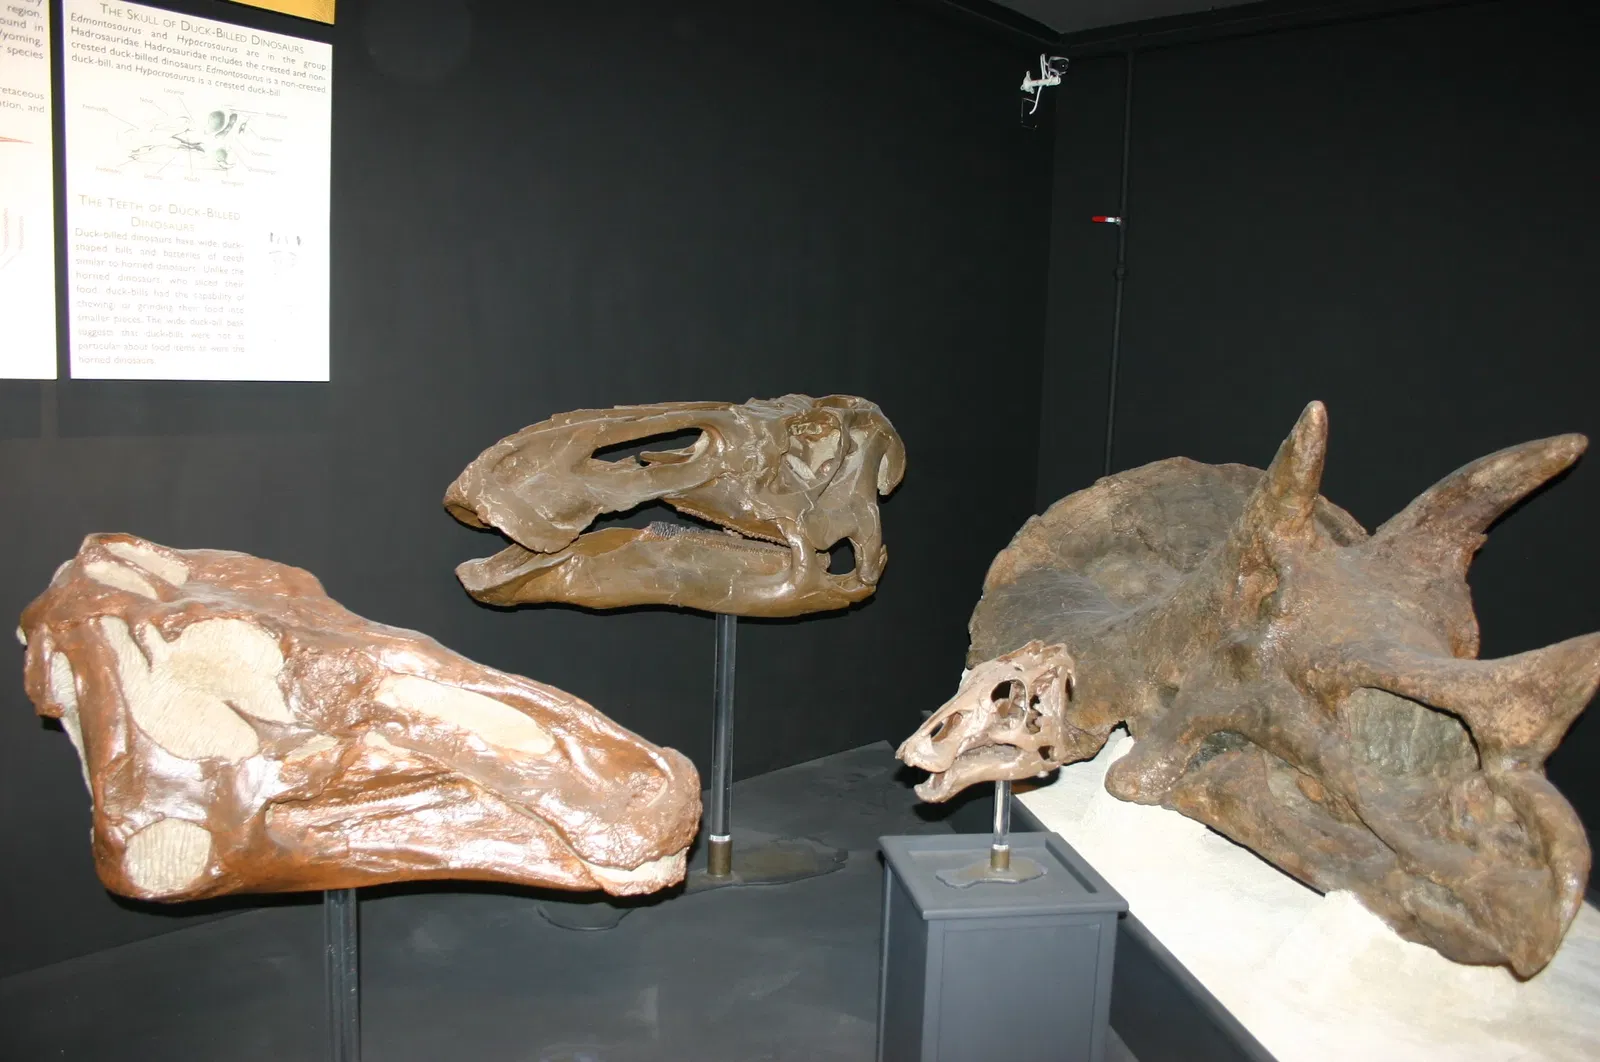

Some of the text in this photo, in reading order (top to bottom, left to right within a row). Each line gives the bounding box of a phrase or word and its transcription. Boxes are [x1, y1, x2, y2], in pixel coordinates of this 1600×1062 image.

[6, 4, 43, 18] region.
[0, 17, 44, 33] ound in
[99, 2, 305, 54] THE SKULL OF DUCK-BILLED DINOSAURS
[7, 46, 44, 60] species
[151, 31, 168, 40] and
[246, 49, 260, 58] are
[267, 52, 275, 60] in
[282, 55, 296, 64] the
[303, 60, 327, 71] group
[71, 41, 107, 54] crested
[109, 47, 158, 64] duck-billed
[265, 75, 272, 84] is
[280, 79, 326, 94] non-crested
[144, 40, 207, 60] Hadrosauridae
[210, 54, 243, 67] includes
[245, 59, 259, 69] the
[261, 63, 291, 76] crested
[292, 69, 307, 79] and
[309, 73, 326, 81] non-
[115, 62, 132, 72] and
[198, 77, 204, 85] is
[214, 81, 245, 93] crested
[28, 104, 45, 113] and
[79, 194, 241, 221] THE TEETH OF DUCK-BILLED
[131, 216, 195, 232] DINOSAURS
[75, 227, 128, 241] Duck-billed
[131, 232, 172, 244] dinosaurs
[176, 236, 194, 246] have
[222, 240, 245, 249] duck-
[75, 243, 245, 263] shaped bills and batteries of teeth
[75, 257, 105, 268] similar
[108, 260, 119, 268] to
[121, 259, 153, 270] horned
[203, 264, 229, 275] Unlike
[231, 267, 245, 276] the
[75, 271, 110, 281] horned
[169, 277, 188, 285] who
[224, 279, 245, 288] their
[105, 285, 149, 297] duck-bills
[153, 288, 170, 298] had
[175, 290, 188, 299] the
[236, 293, 245, 302] of
[137, 303, 173, 314] grinding
[204, 304, 224, 313] food
[77, 313, 111, 323] smaller
[166, 316, 187, 325] wide
[78, 328, 114, 340] suggests
[120, 328, 139, 337] that
[145, 328, 184, 338] duck-bills
[191, 331, 210, 339] were
[78, 341, 121, 352] particular
[123, 341, 148, 351] about
[151, 343, 171, 352] food
[78, 355, 111, 364] horned
